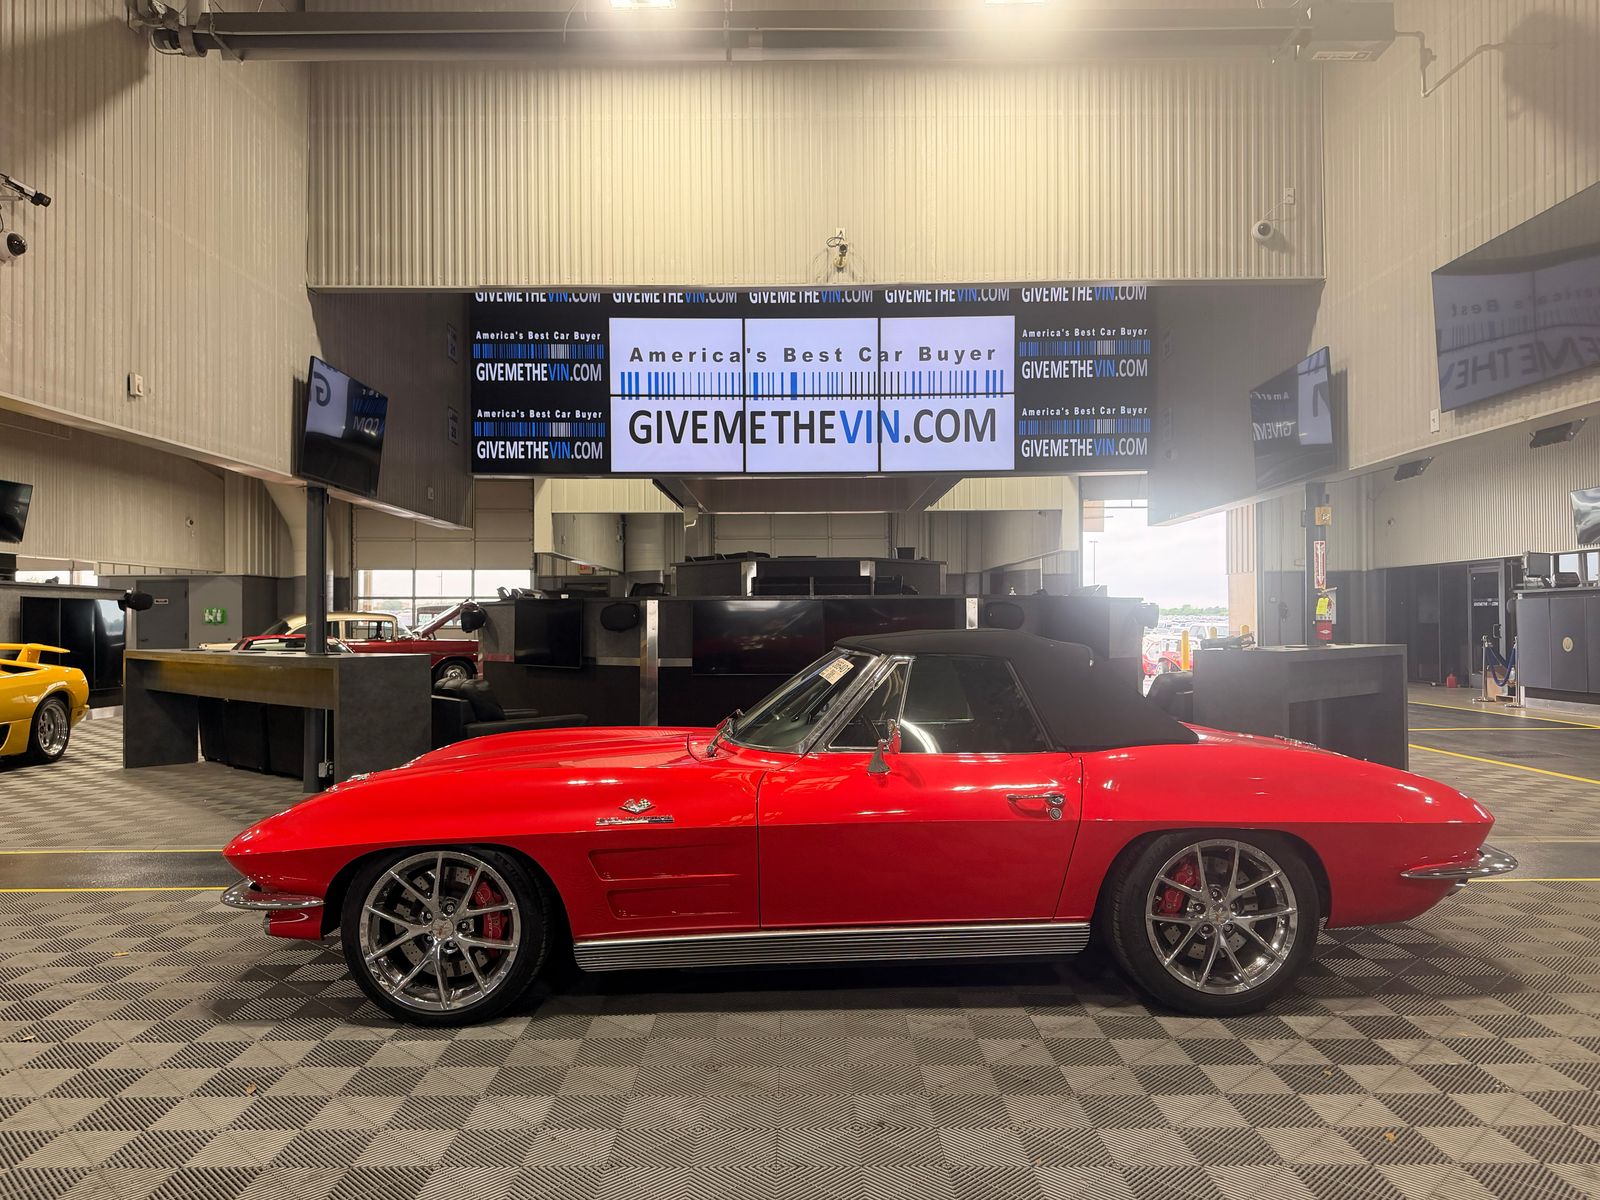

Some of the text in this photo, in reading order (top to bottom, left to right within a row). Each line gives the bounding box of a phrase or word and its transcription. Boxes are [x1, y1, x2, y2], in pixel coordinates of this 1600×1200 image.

[475, 331, 601, 342] America's Best Car Buyer
[1022, 327, 1148, 338] America's Best Car Buyer
[629, 346, 996, 364] America's Best Car Buyer
[476, 362, 602, 382] GIVEMETHEVIN.COM
[1021, 359, 1148, 379] GIVEMETHEVIN.COM
[476, 409, 602, 421] America's Best Car Buyer
[1021, 406, 1148, 417] America's Best Car Buyer
[629, 408, 996, 445] GIVEMETHEVIN.COM
[477, 440, 603, 460] GIVEMETHEVIN.COM
[1021, 437, 1148, 458] GIVEMETHEVIN.COM
